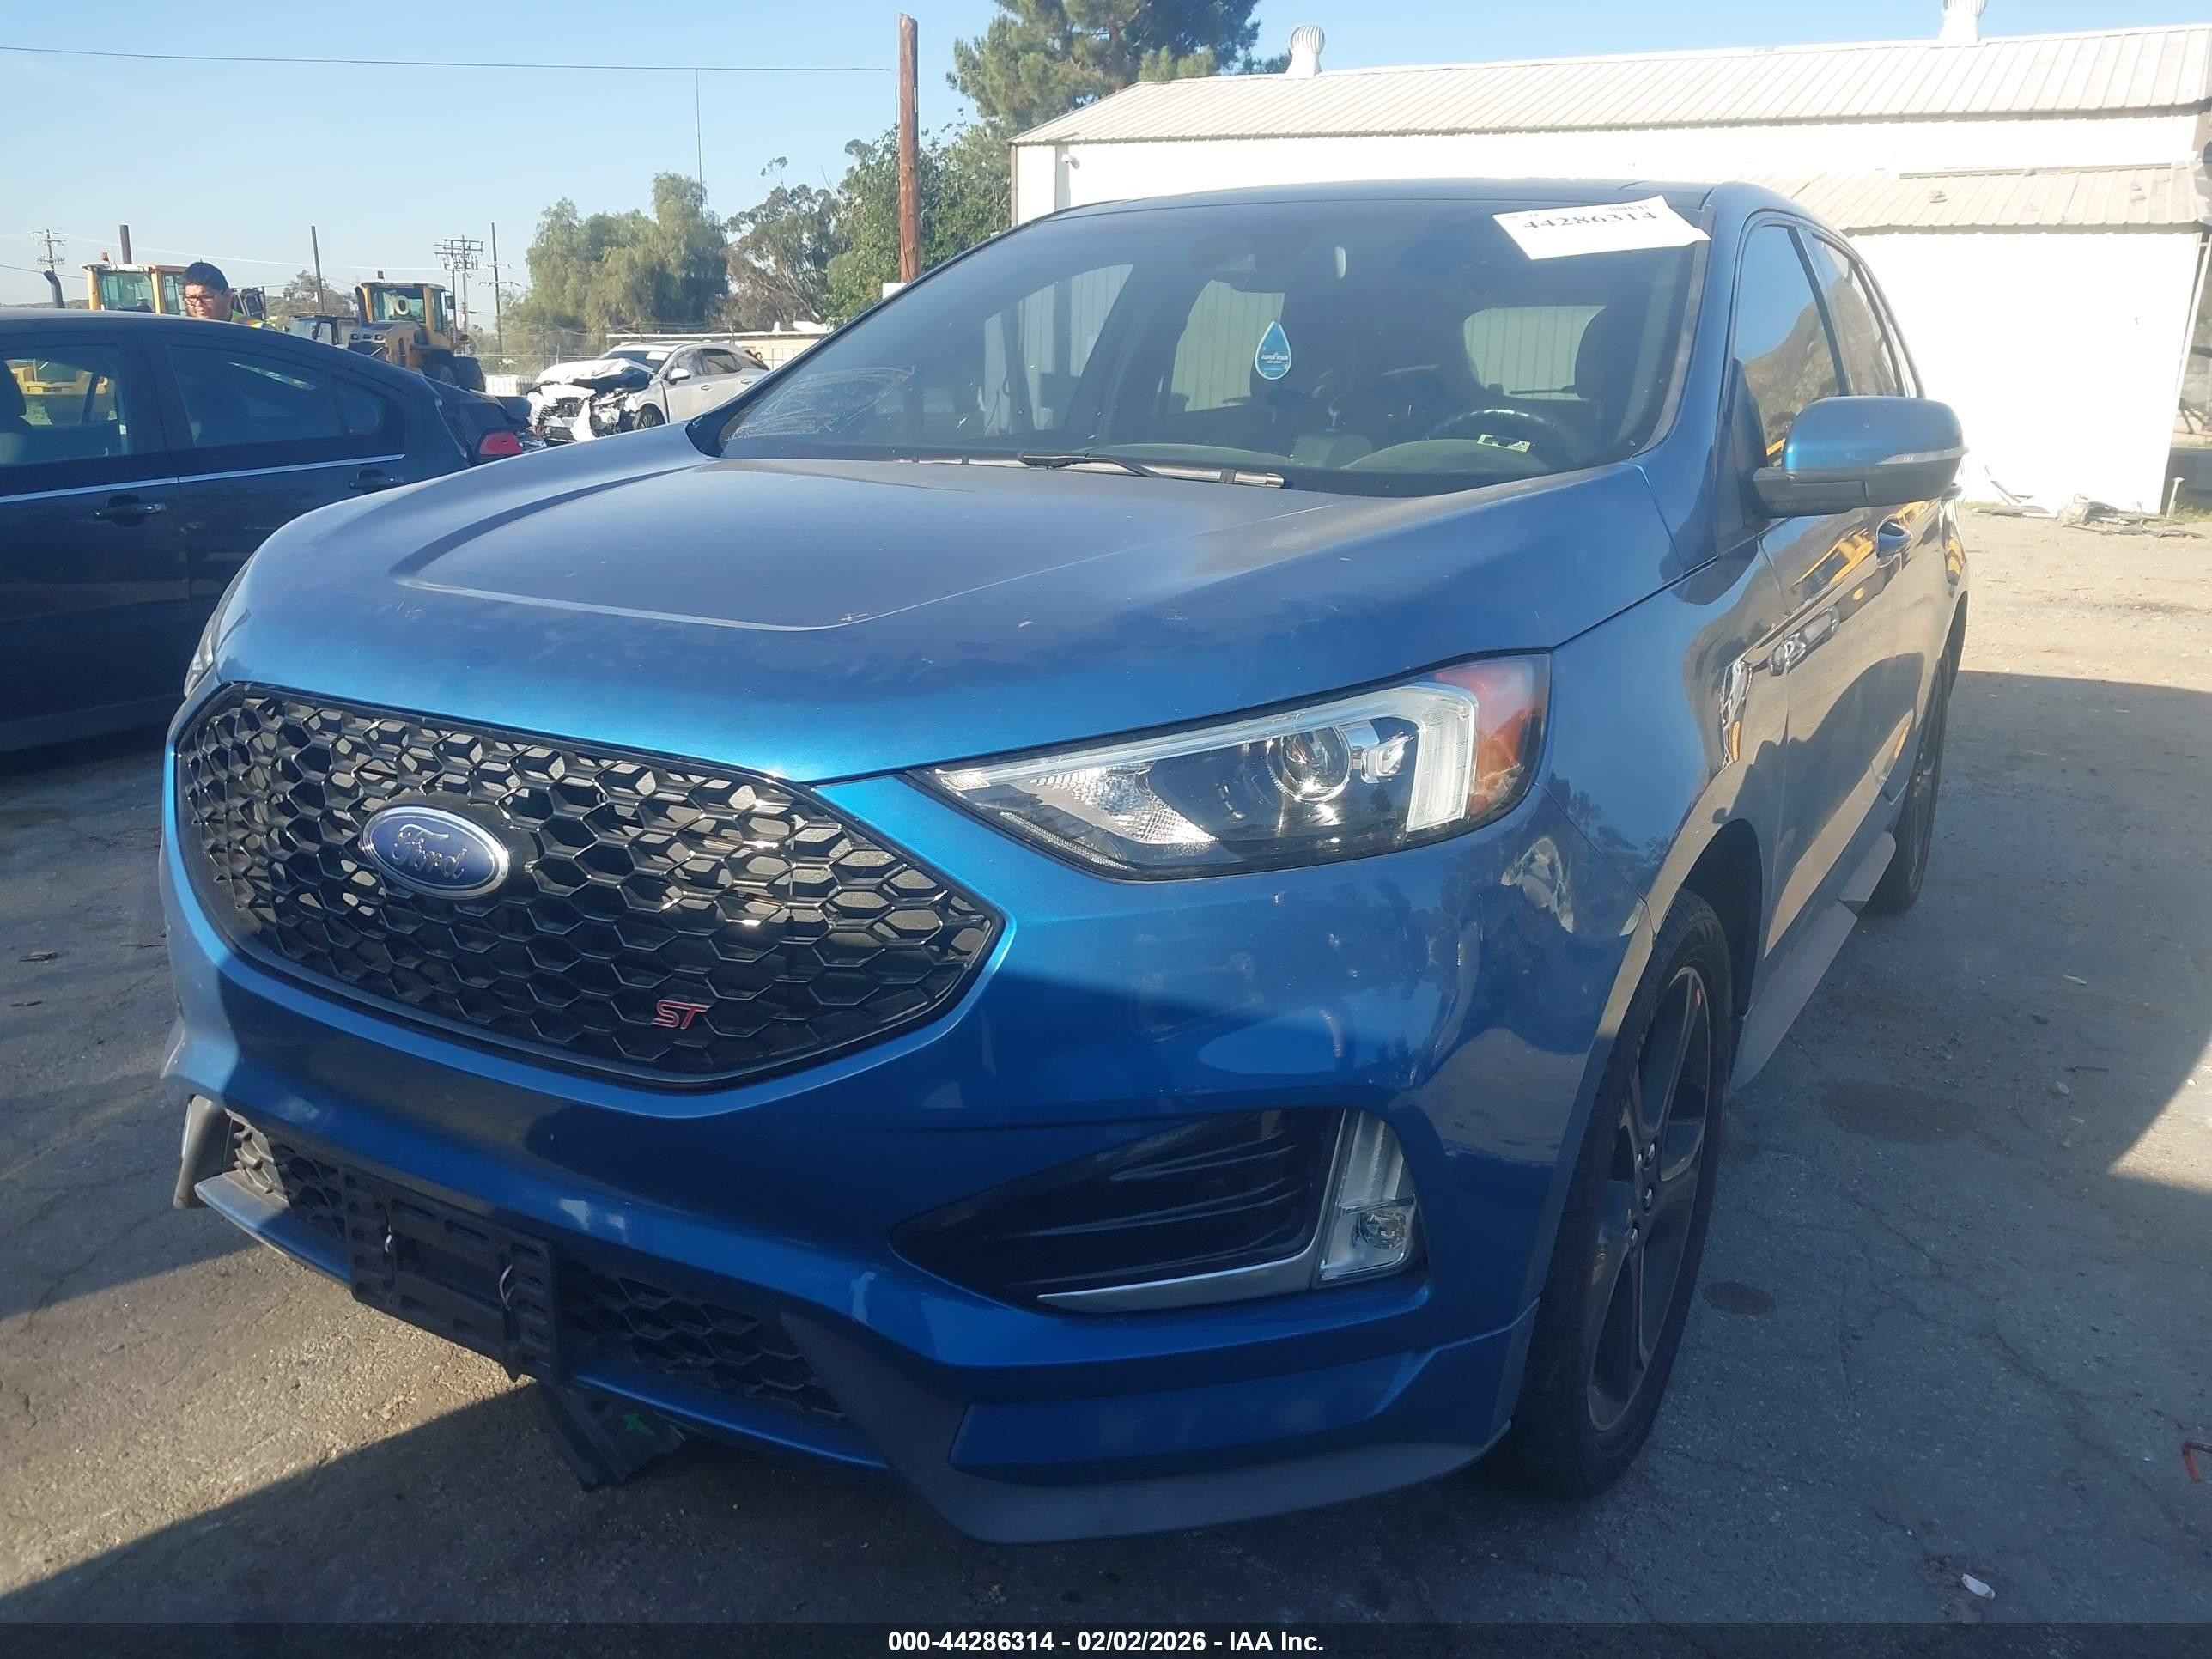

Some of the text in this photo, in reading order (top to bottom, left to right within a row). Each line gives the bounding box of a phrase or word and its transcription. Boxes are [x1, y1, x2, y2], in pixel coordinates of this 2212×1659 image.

[1523, 211, 1656, 228] 44286314
[392, 823, 468, 880] Ford
[653, 999, 712, 1030] ST
